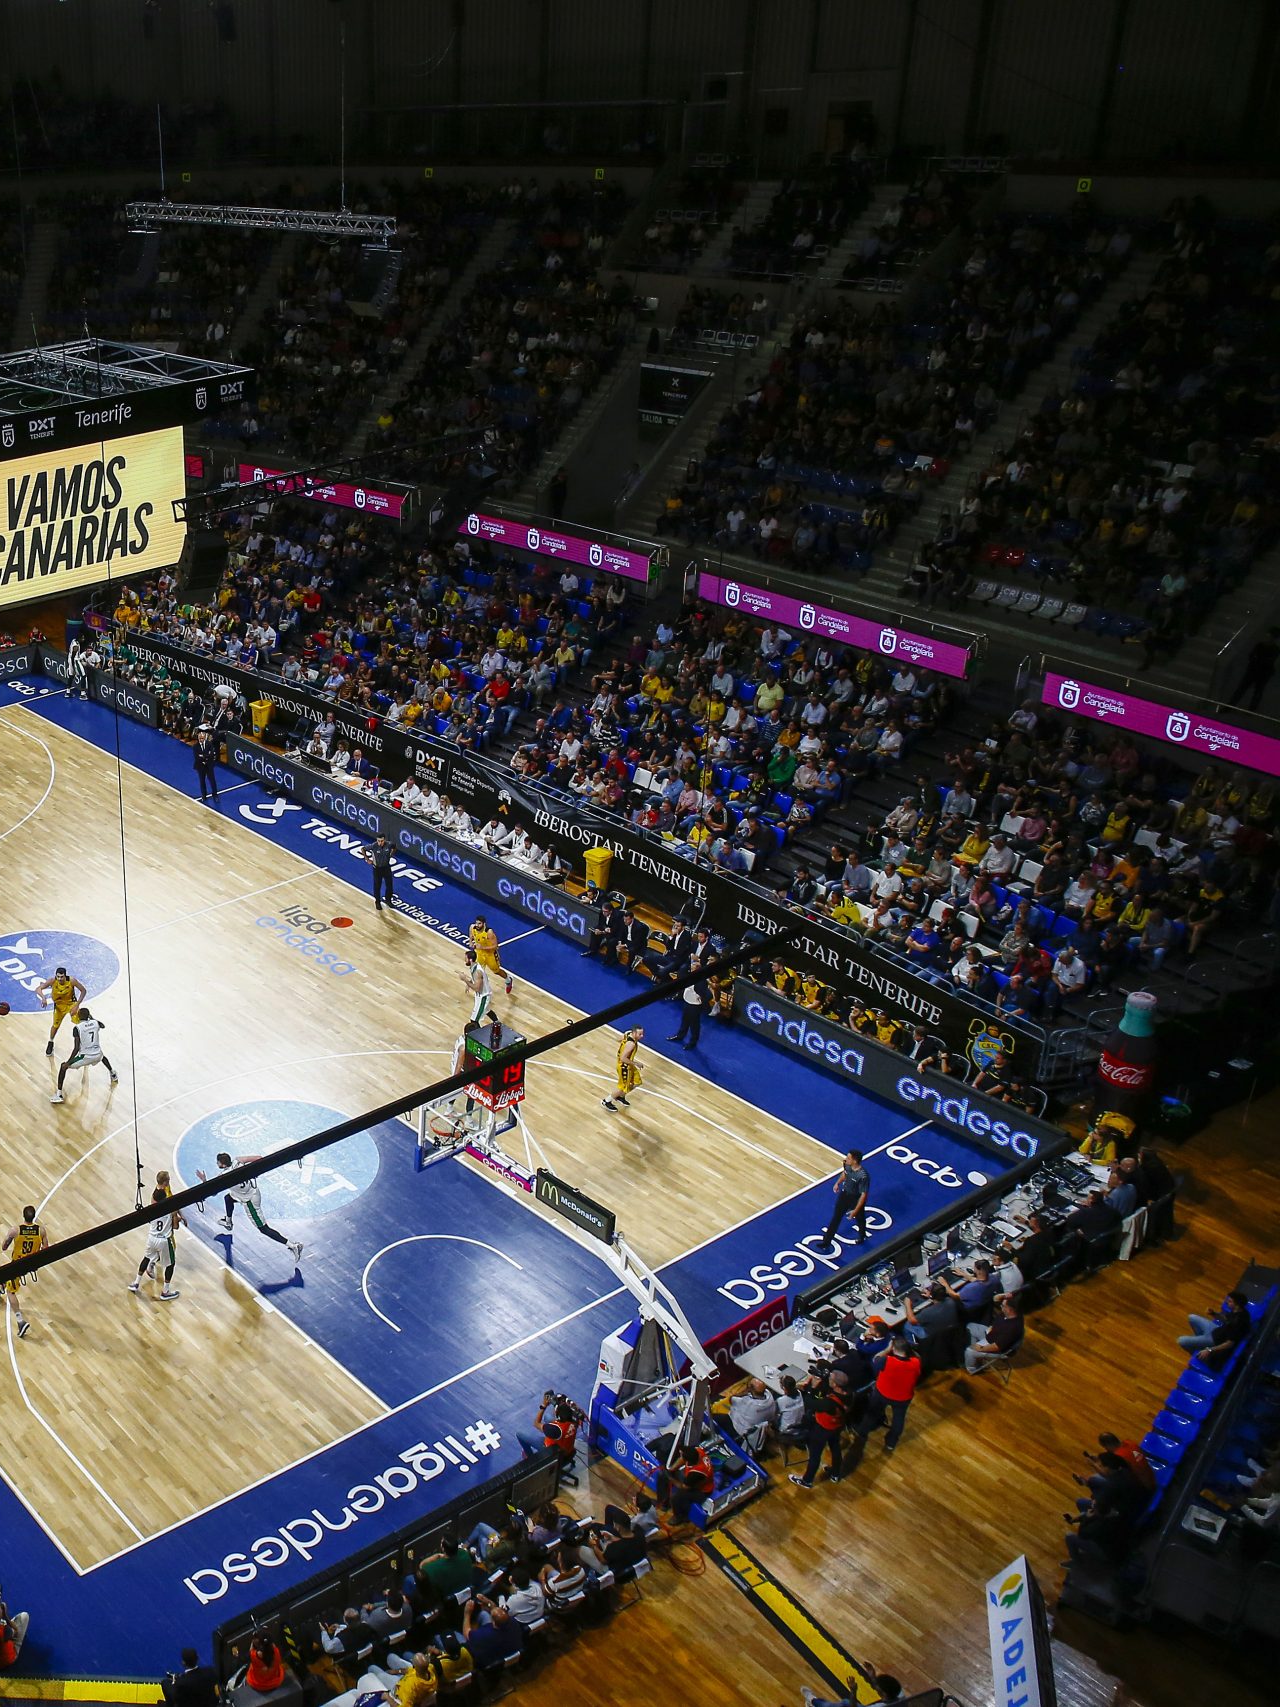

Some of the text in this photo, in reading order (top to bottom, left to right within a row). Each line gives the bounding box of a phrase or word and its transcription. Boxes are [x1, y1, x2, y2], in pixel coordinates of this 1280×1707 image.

[220, 381, 245, 396] DXT
[29, 416, 56, 432] DXT
[74, 402, 132, 428] Tenerife
[30, 430, 55, 440] TENERIFE
[6, 455, 127, 531] VAMOS
[742, 594, 771, 609] Candelaria
[817, 616, 850, 632] Candelaria
[899, 641, 934, 658] Candelaria
[127, 643, 243, 694] IBEROSTAR TENERIFE
[7, 681, 36, 695] acb
[258, 690, 324, 723] IBEROSTAR
[1083, 695, 1125, 715] Candelaria
[1193, 728, 1240, 750] Candelaria
[233, 747, 295, 791] endesa
[415, 749, 445, 771] DXT
[415, 764, 438, 778] DEPORTES
[452, 768, 471, 781] Pabellón
[477, 779, 495, 793] Deportes
[457, 776, 475, 790] Tenerife
[311, 783, 380, 833] endesa
[400, 828, 477, 881] endesa
[532, 808, 709, 901] IBEROSTAR TENERIFE
[279, 904, 332, 935] liga
[497, 877, 586, 936] endesa
[255, 915, 358, 977] endesa
[843, 958, 943, 1028] TENERIFE
[88, 1031, 95, 1043] 7
[745, 1001, 865, 1076] endesa
[466, 1082, 492, 1107] Libby's
[493, 1086, 525, 1110] Libby's
[897, 1077, 1039, 1158] endesa
[886, 1145, 963, 1187] acb
[156, 1220, 164, 1232] 8
[560, 1196, 602, 1228] McDonald's
[714, 1309, 787, 1365] ndesa
[183, 1419, 501, 1605] #ligaendesa
[1001, 1617, 1029, 1707] ADE
